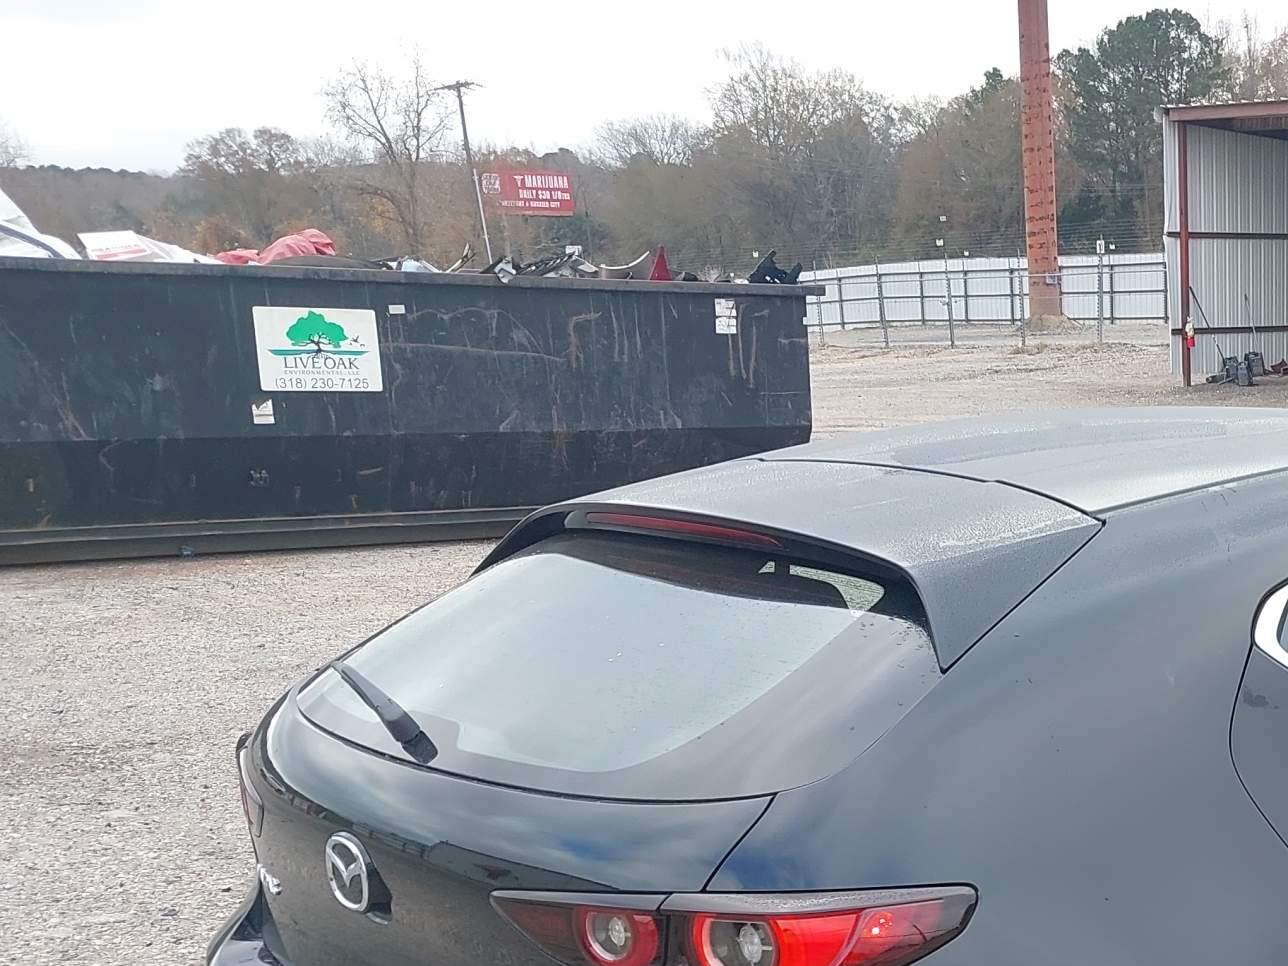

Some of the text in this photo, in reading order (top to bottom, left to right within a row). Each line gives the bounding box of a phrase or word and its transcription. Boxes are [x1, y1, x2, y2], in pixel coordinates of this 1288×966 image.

[524, 174, 569, 189] MARIJUANA
[518, 189, 537, 199] DAILY
[284, 357, 360, 370] LIVE OAK
[275, 378, 369, 389] (318) 230-7125
